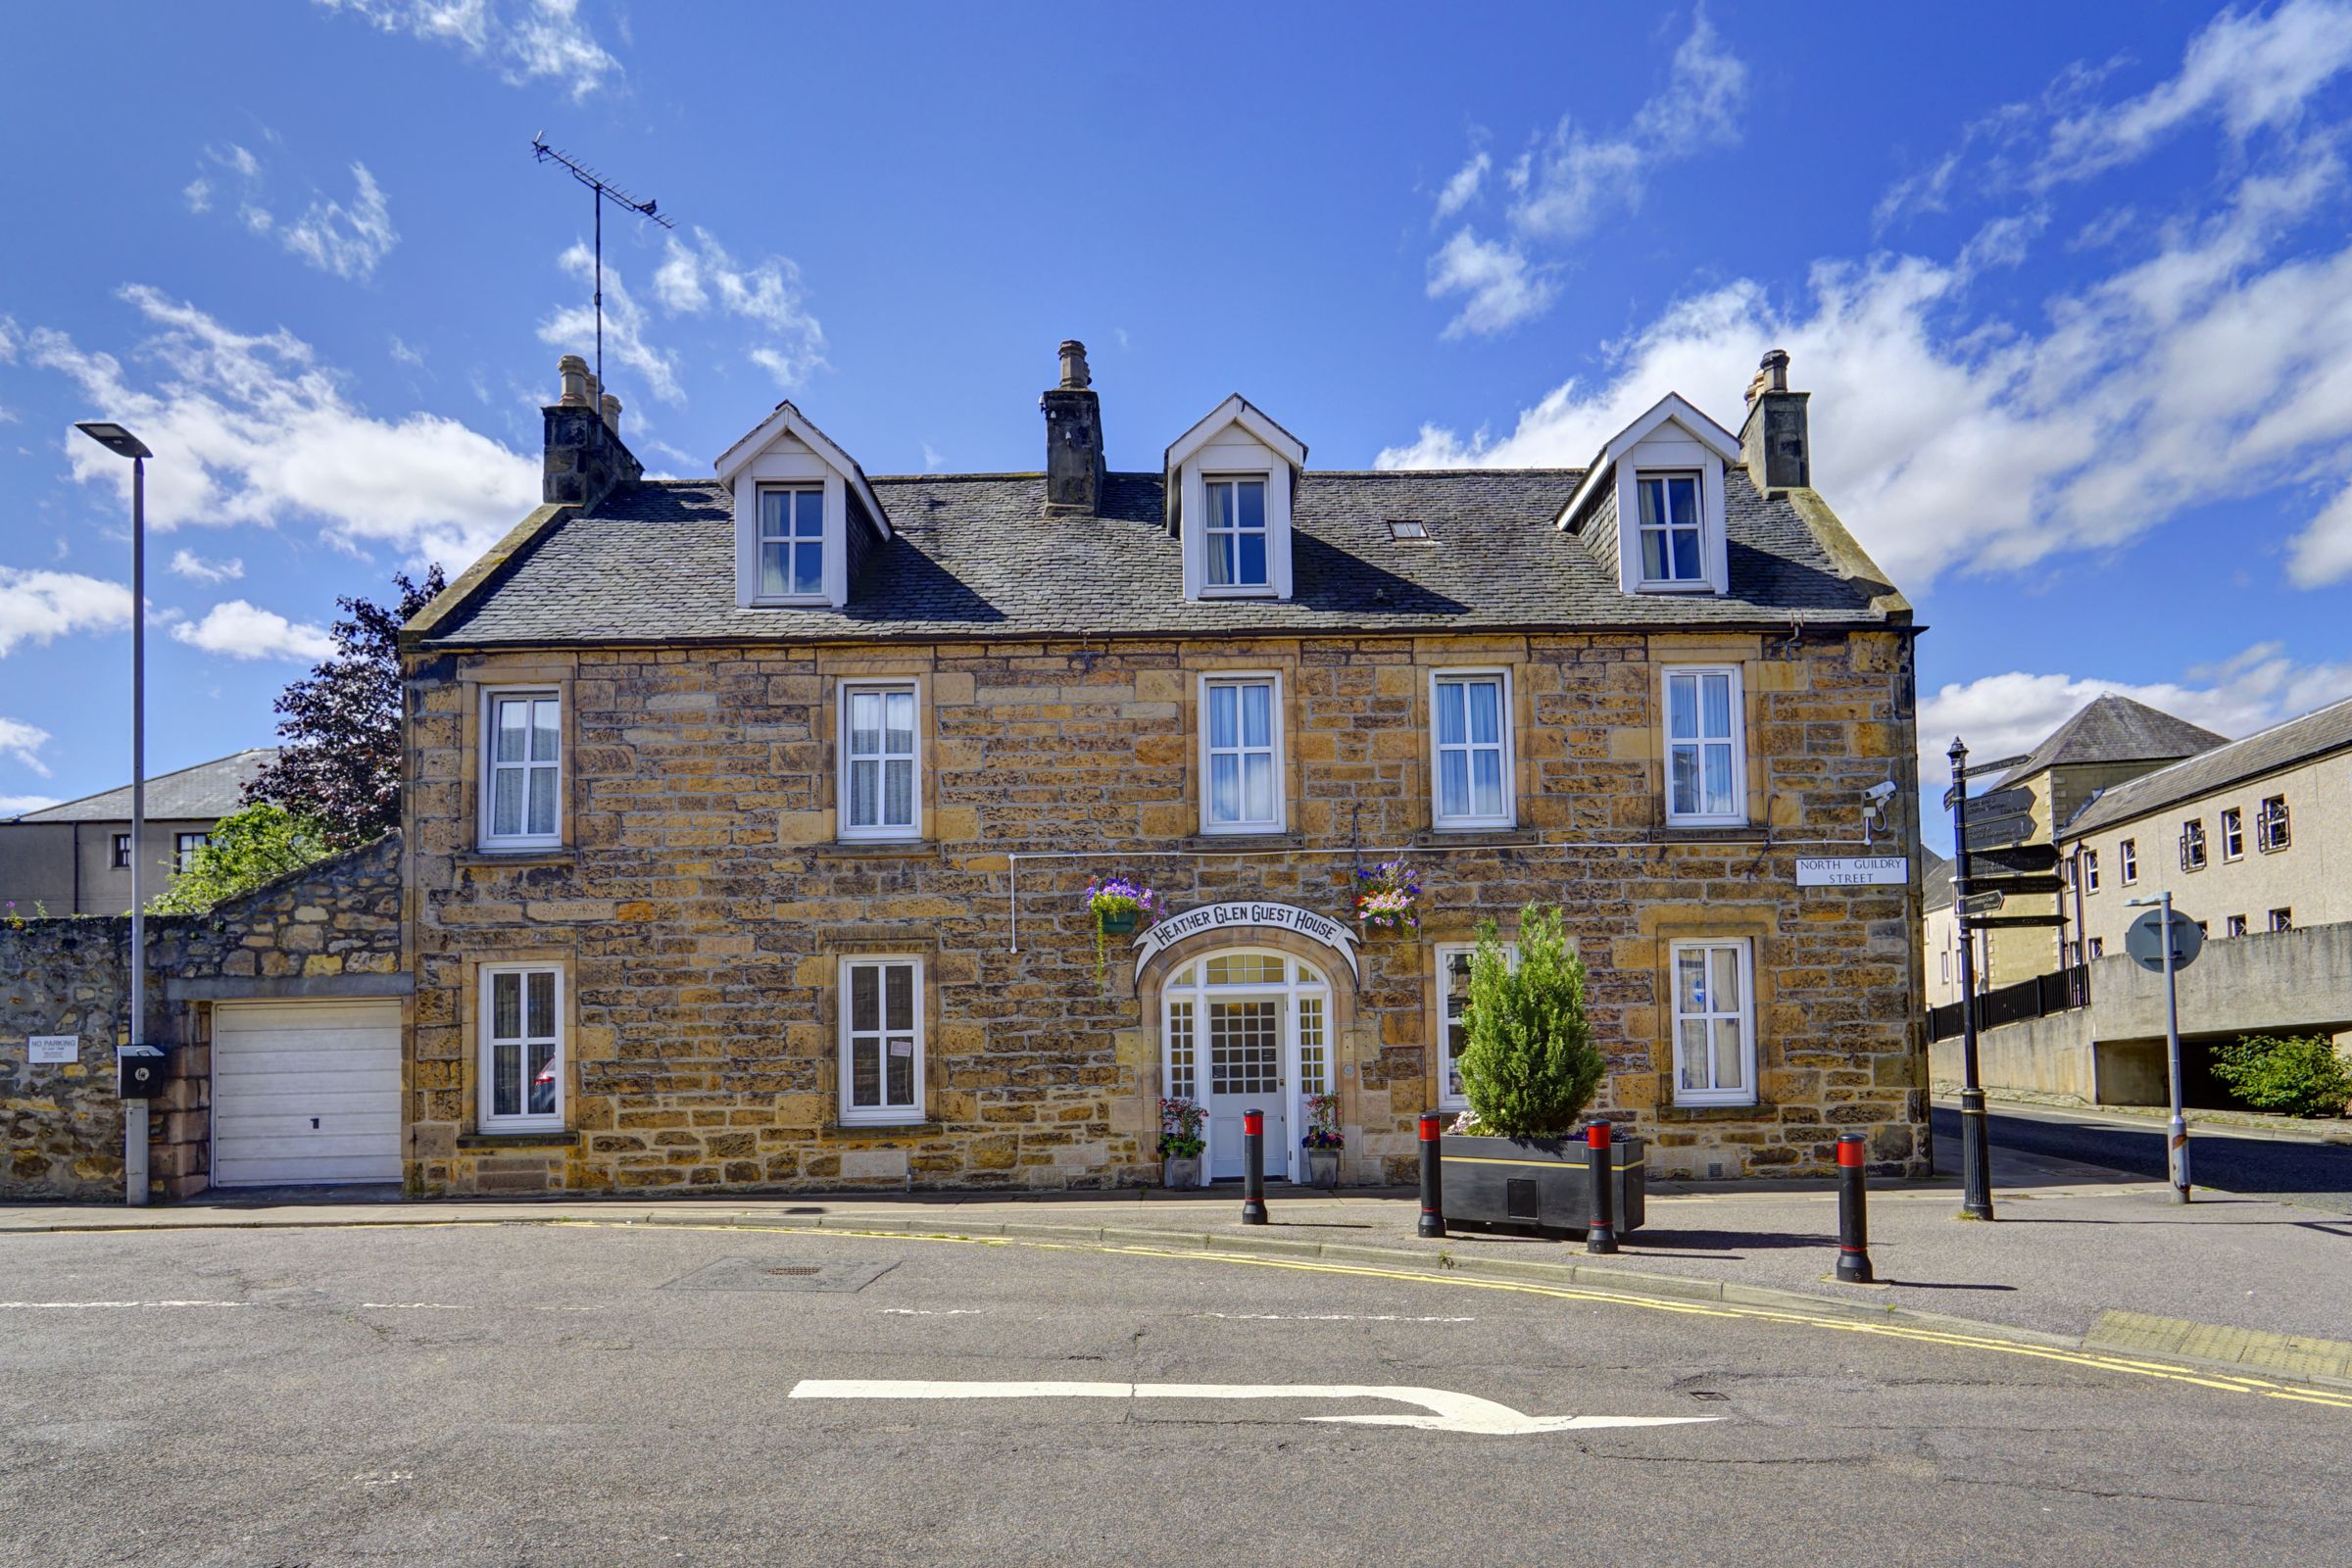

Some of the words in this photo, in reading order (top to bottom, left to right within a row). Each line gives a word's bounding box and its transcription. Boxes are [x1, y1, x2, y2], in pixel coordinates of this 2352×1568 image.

[1800, 859, 1841, 870] NORTH
[1853, 858, 1902, 869] GUILDRY
[1829, 873, 1874, 884] STREET
[1154, 910, 1211, 946] HEATHER
[1214, 905, 1249, 925] GLEN
[1251, 904, 1294, 925] GUEST
[1294, 909, 1337, 941] HOUSE
